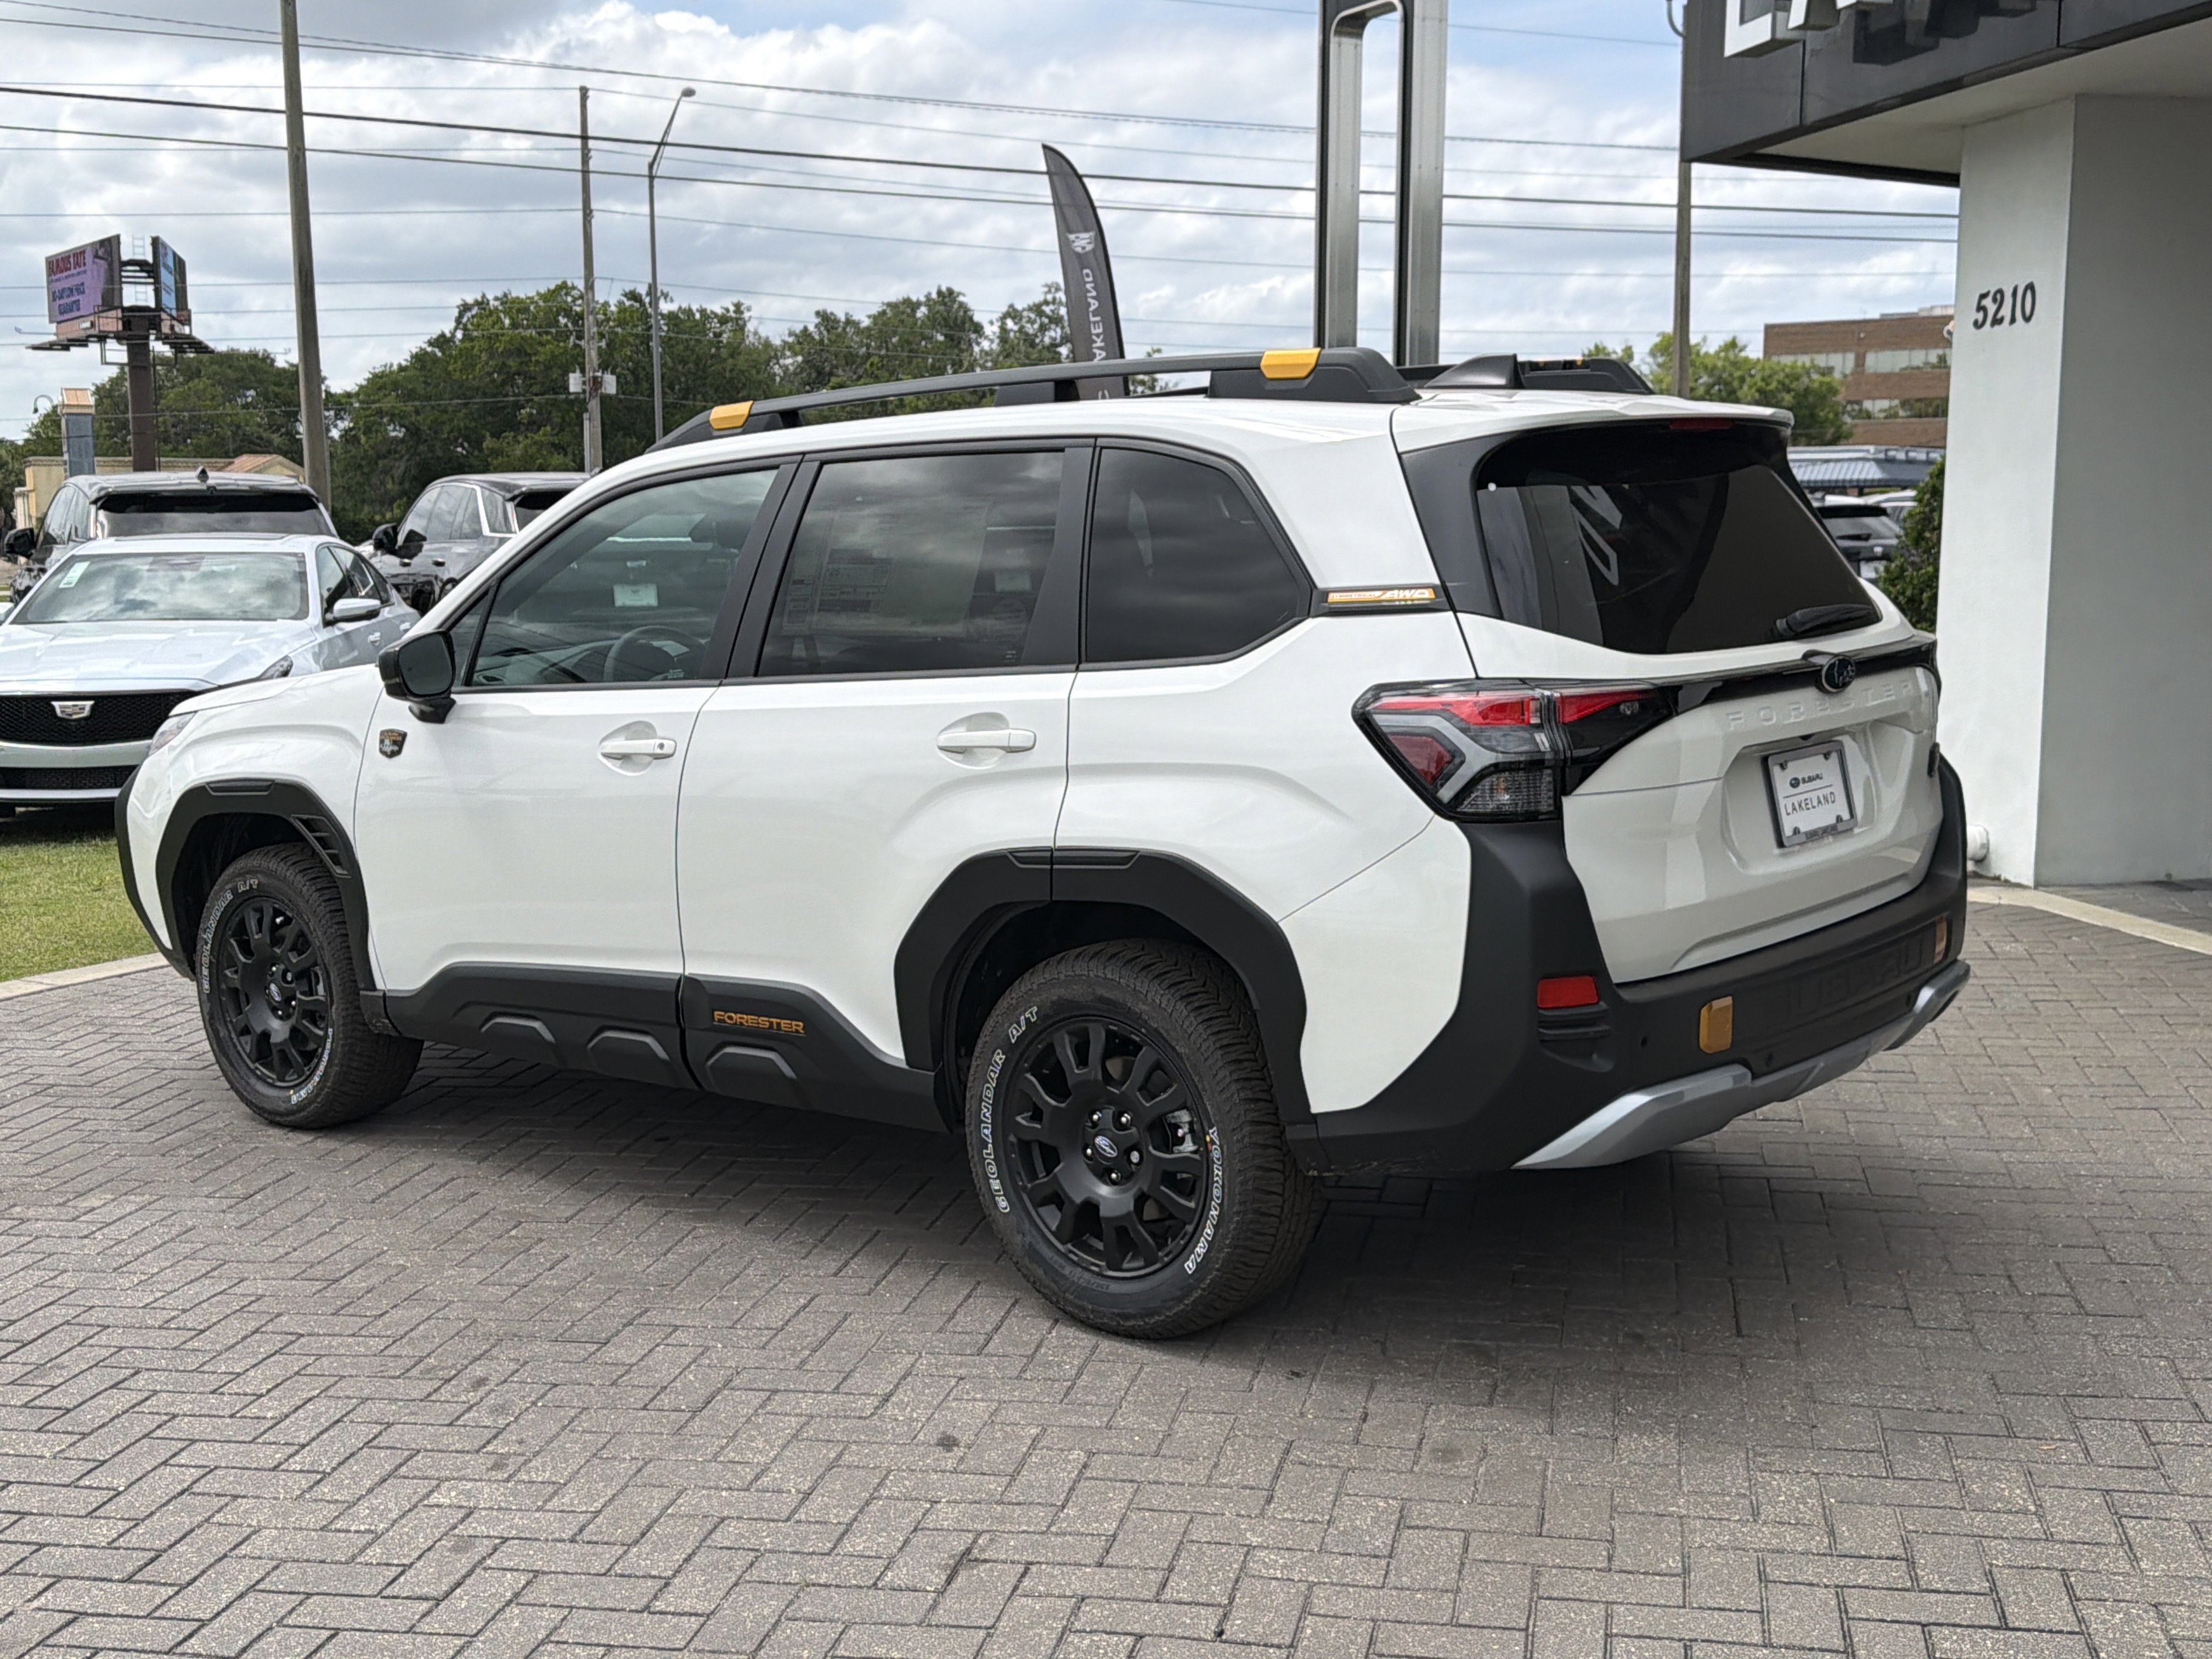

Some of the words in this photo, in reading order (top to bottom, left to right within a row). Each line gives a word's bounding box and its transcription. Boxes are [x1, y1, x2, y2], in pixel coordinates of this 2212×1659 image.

[1972, 281, 2036, 330] 5210
[1784, 791, 1836, 816] LAKELAND
[714, 1011, 805, 1034] FORESTER
[980, 1049, 1011, 1213] GEOLANDAR
[1008, 1006, 1038, 1043] A/T
[1184, 1126, 1222, 1274] YOKOHAMA
